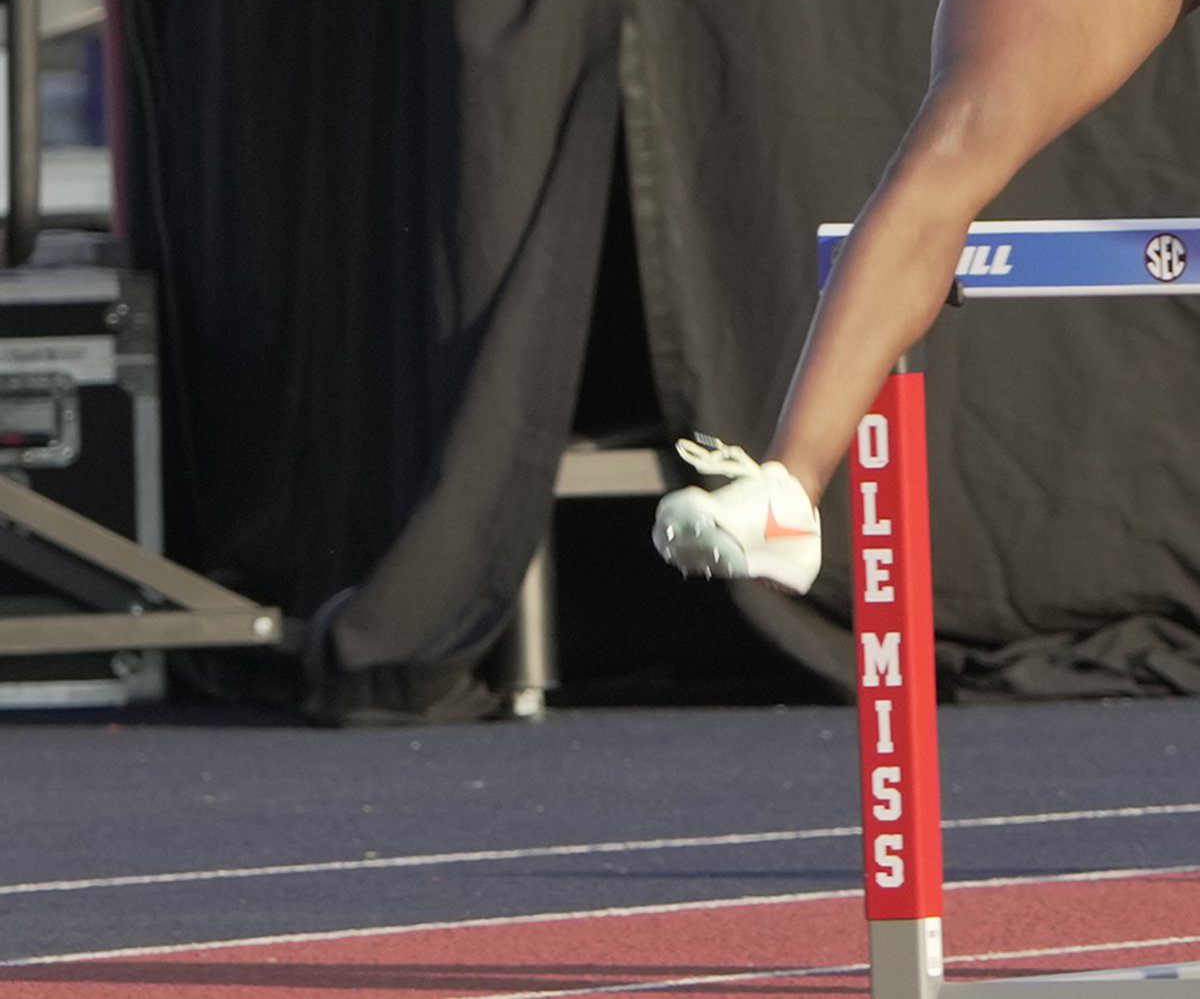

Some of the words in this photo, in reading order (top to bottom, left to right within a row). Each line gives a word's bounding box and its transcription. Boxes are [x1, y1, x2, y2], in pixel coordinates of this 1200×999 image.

[955, 245, 1013, 275] ILL
[1145, 233, 1187, 282] SEC
[858, 414, 894, 603] OLE
[861, 632, 905, 889] MISS
